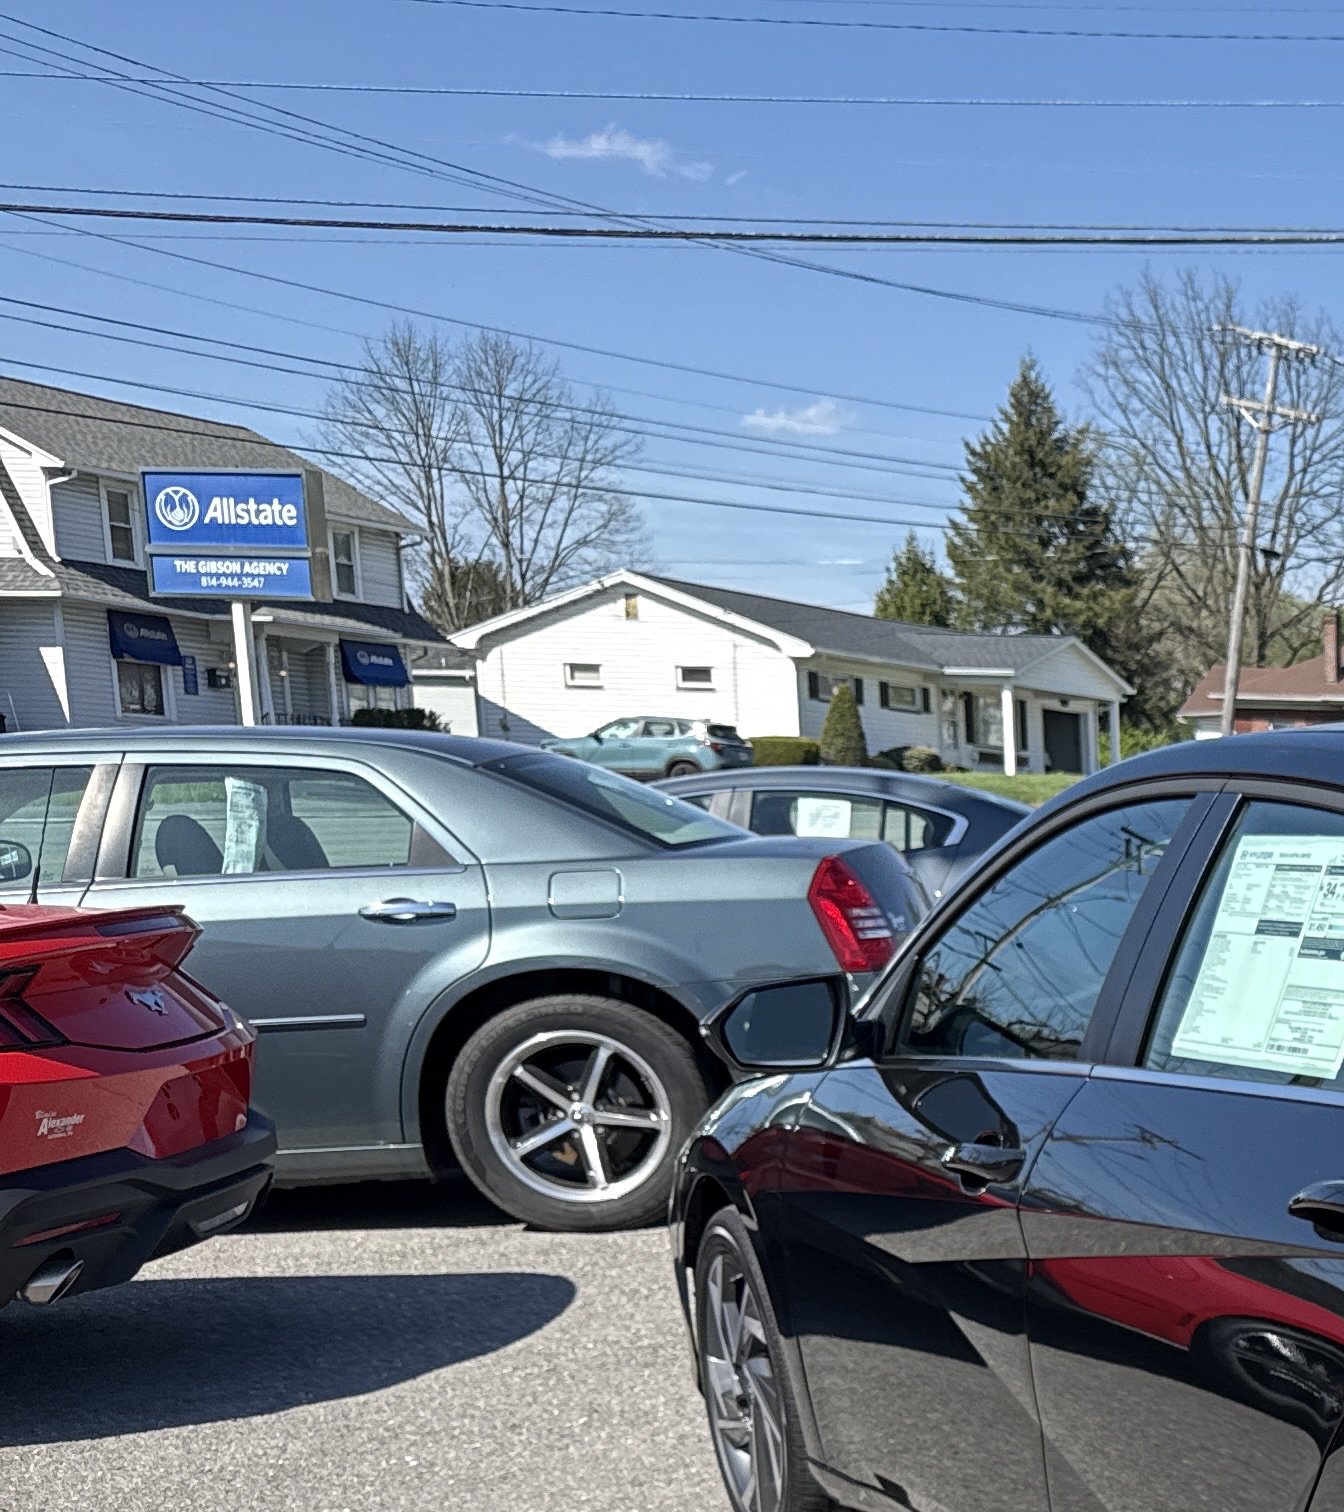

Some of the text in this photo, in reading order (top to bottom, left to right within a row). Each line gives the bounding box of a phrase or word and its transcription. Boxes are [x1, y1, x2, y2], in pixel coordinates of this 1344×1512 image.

[204, 496, 298, 526] Allstate
[174, 560, 289, 576] THE GIBSON AGENCY
[201, 576, 265, 589] 814-944-3547
